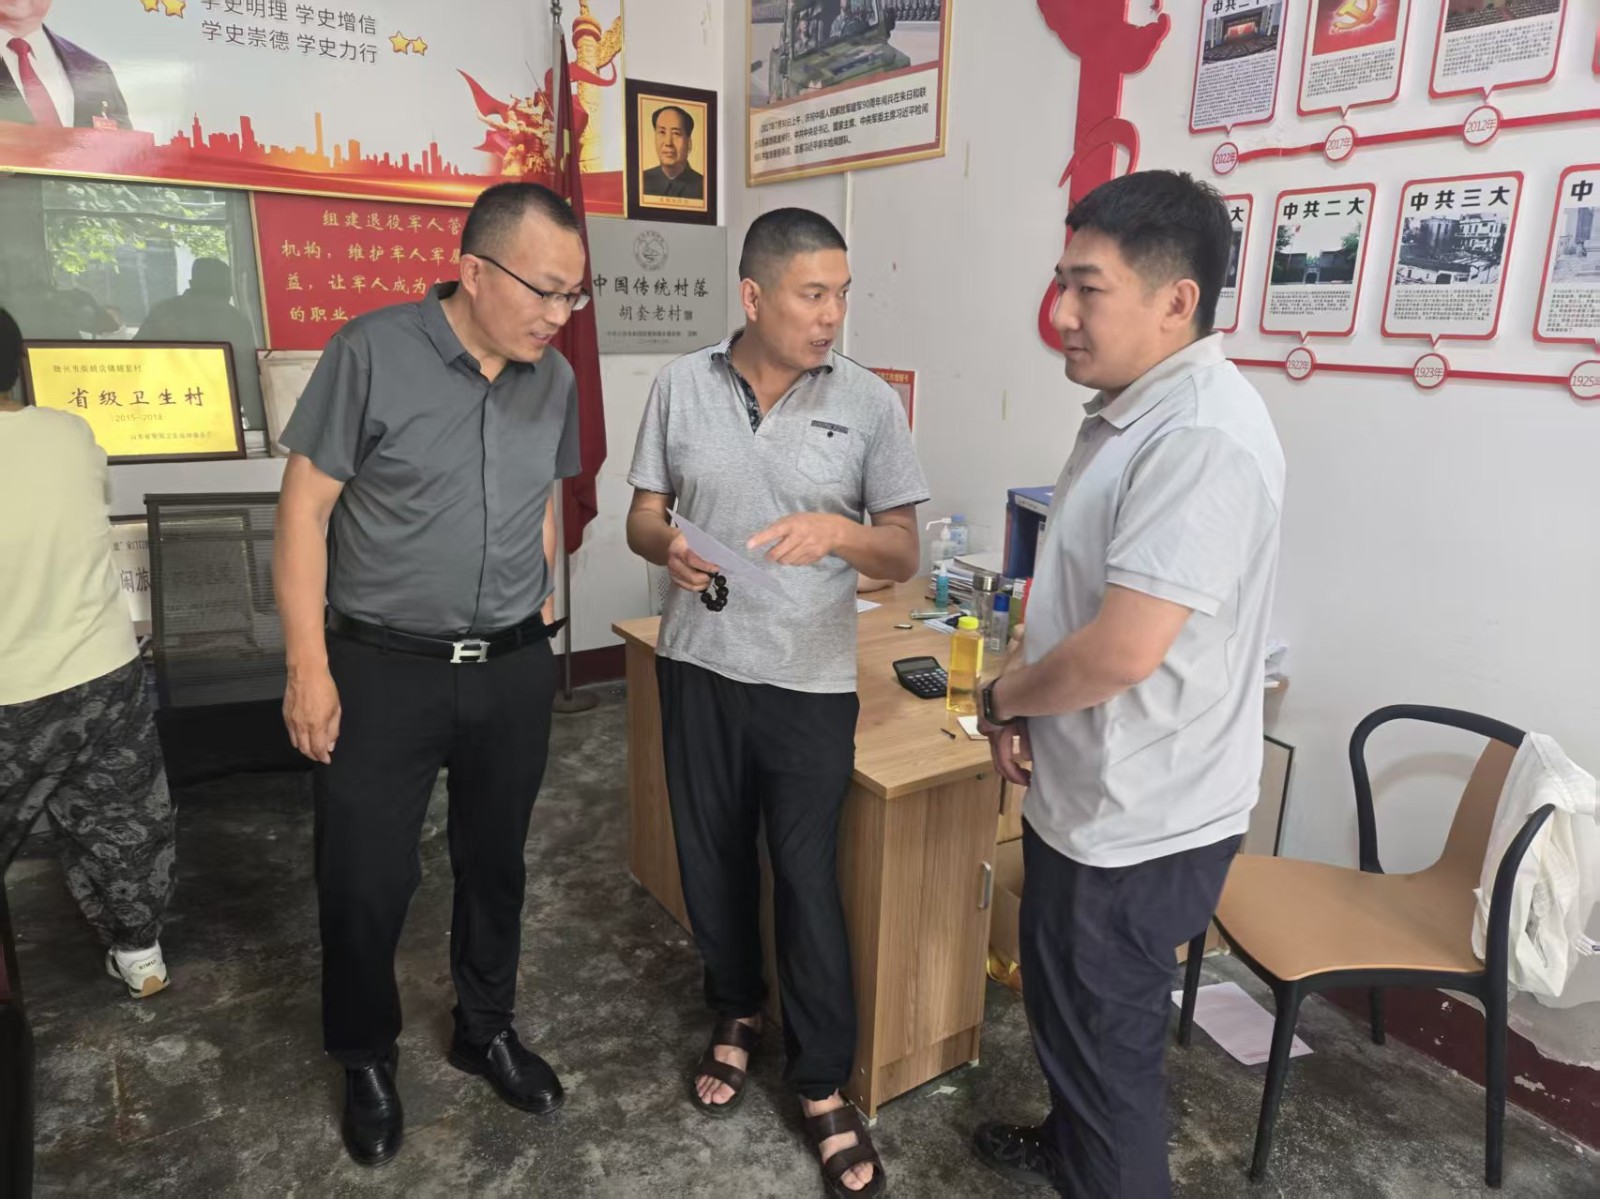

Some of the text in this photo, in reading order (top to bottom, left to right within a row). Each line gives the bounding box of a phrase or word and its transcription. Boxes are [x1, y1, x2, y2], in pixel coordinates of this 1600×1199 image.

[295, 4, 376, 36] 学史增信
[201, 20, 378, 64] 学史崇德 学史力行
[1465, 118, 1497, 133] 2012年
[1327, 136, 1352, 151] 2017年
[1215, 152, 1236, 165] 2022年
[1410, 186, 1510, 211] 中共三大
[1570, 180, 1594, 202] 中
[1283, 197, 1365, 220] 中共二大
[286, 273, 441, 295] 益，让军人成为
[593, 274, 709, 297] 中国传统村落
[1287, 360, 1310, 371] 1922年
[1416, 367, 1443, 379] 1923年
[67, 387, 204, 409] 省级卫生村
